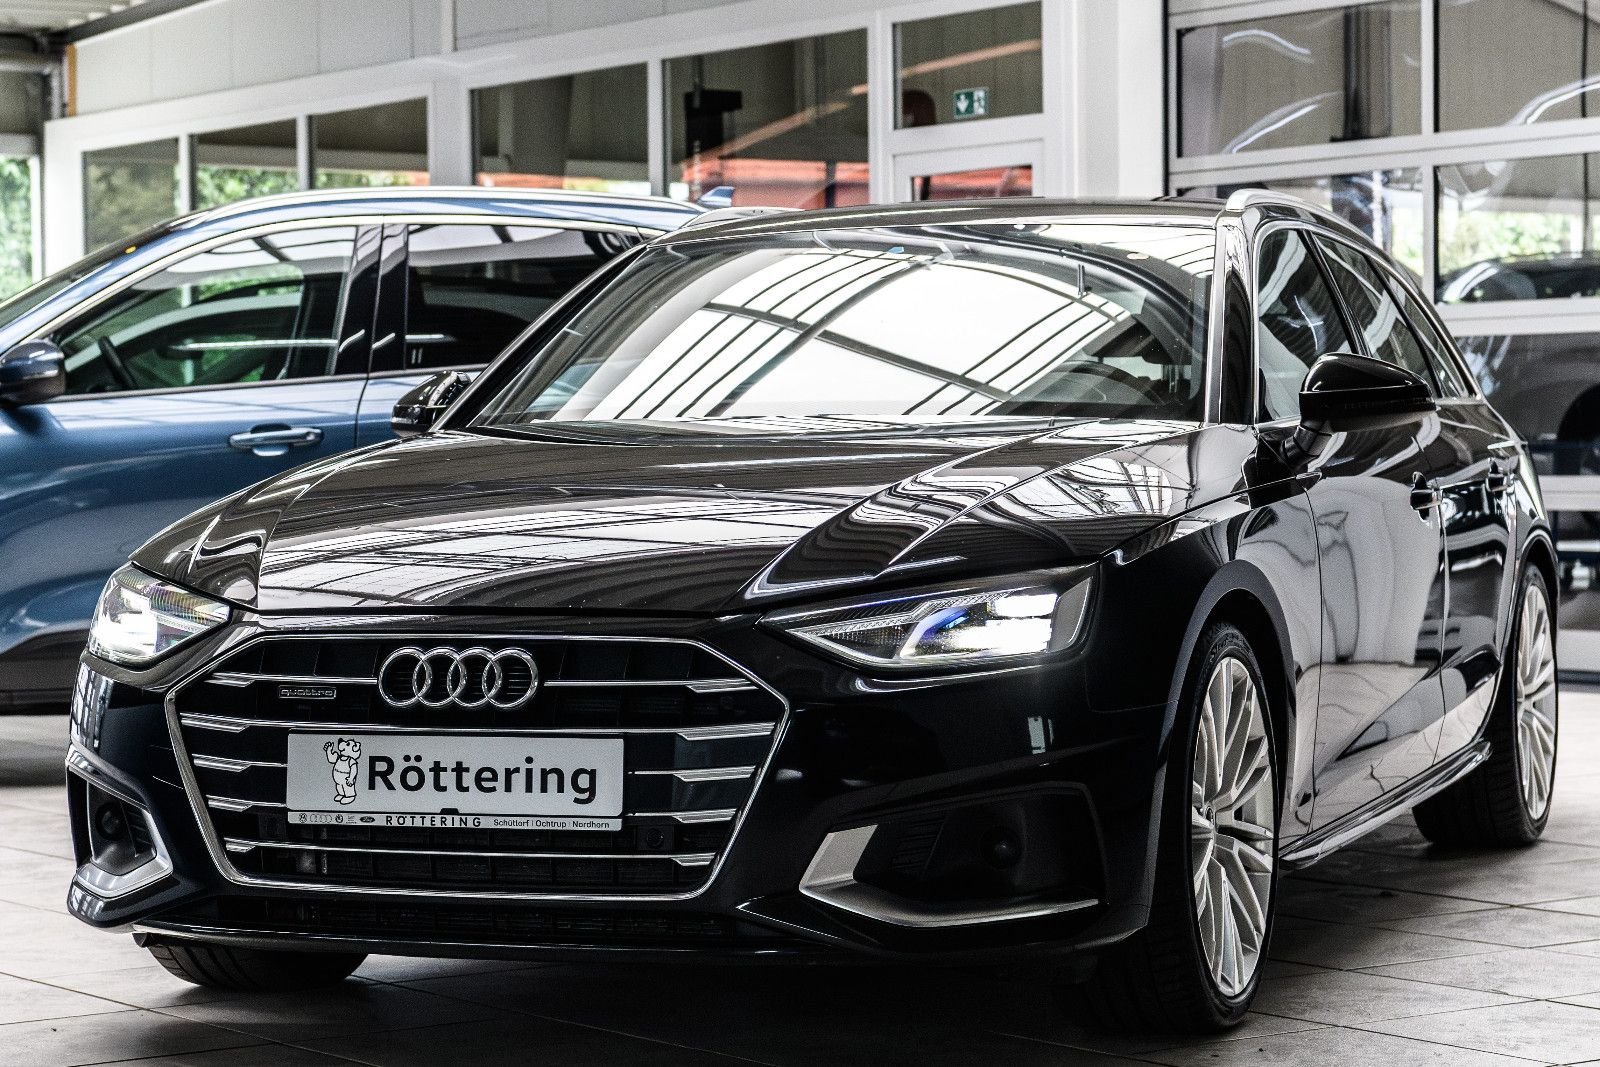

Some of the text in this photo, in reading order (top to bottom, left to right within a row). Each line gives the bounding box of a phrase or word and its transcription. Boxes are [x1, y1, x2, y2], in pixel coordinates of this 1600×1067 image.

[281, 689, 333, 697] quattro
[368, 755, 597, 805] Röttering
[386, 815, 481, 827] RÖTTERING
[535, 820, 567, 829] Ochtrup
[572, 820, 610, 829] Nordhorn
